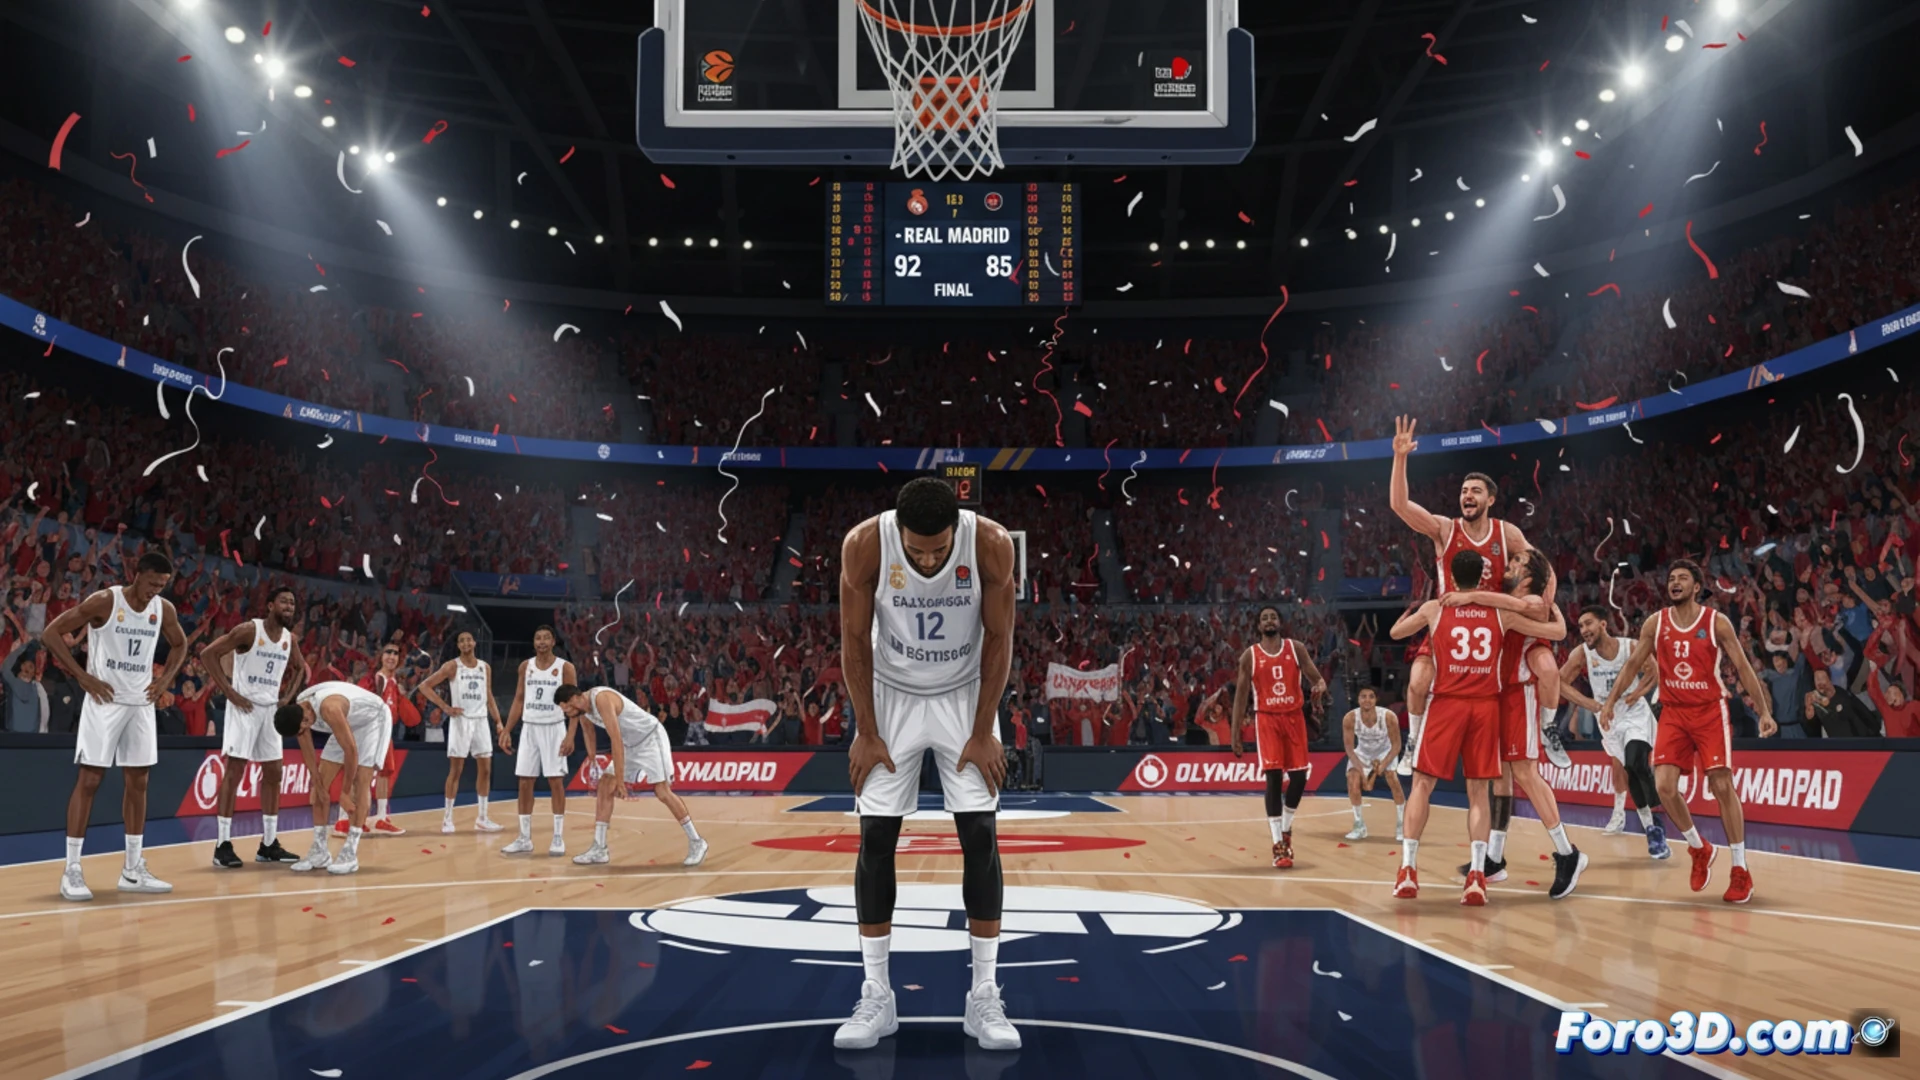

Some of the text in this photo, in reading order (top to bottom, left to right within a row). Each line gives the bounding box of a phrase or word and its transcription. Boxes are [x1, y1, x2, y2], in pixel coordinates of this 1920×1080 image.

[948, 227, 1010, 244] MADRID
[894, 255, 1013, 277] 92 85
[934, 283, 973, 297] FINAL
[915, 611, 946, 641] 12
[1450, 626, 1492, 661] 33
[675, 761, 777, 782] YMADPAD
